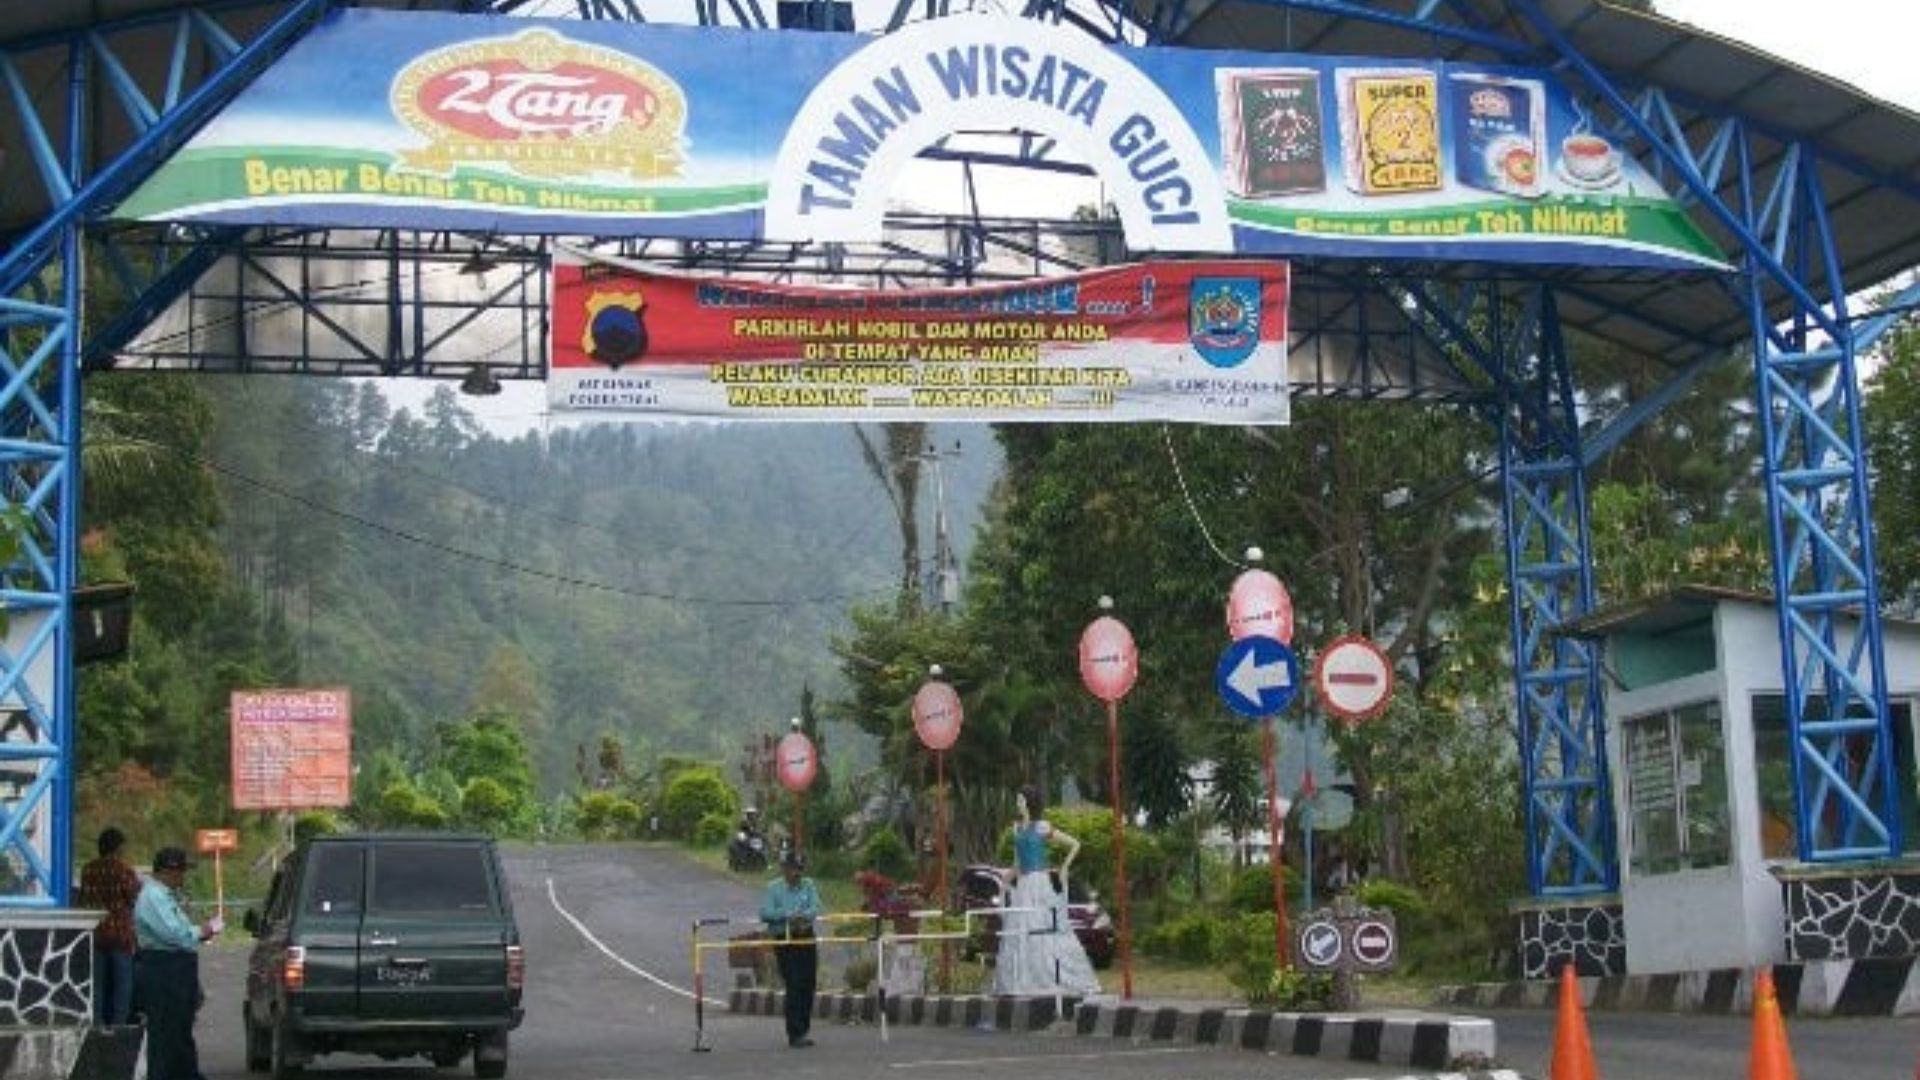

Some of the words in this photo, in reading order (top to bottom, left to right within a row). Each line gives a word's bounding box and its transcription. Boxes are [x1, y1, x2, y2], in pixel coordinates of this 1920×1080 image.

[1368, 85, 1426, 100] SUPER
[798, 66, 921, 214] TAMAN
[927, 44, 1107, 126] WISATA
[1108, 112, 1200, 224] GUCI
[245, 158, 348, 196] Benar
[358, 161, 459, 198] Benar
[470, 179, 527, 204] Teh
[1475, 211, 1523, 234] Teh
[1532, 206, 1626, 235] Nikmat
[734, 318, 850, 337] PARKIRLAH
[857, 321, 921, 339] MOBIL
[926, 322, 969, 340] DAN
[974, 322, 1047, 340] MOTOR
[1053, 323, 1108, 341] ANDA
[805, 342, 826, 360] DI
[832, 343, 911, 362] TEMPAT
[917, 344, 973, 361] YANG
[979, 345, 1038, 364] AMAN
[711, 365, 794, 383] PELAKU
[800, 366, 918, 385] CURANMOR
[922, 366, 965, 386] ADA
[969, 367, 1078, 386] DISEKITAR
[727, 386, 867, 407] WASPADALAH
[911, 388, 1053, 408] WASPADALAH
